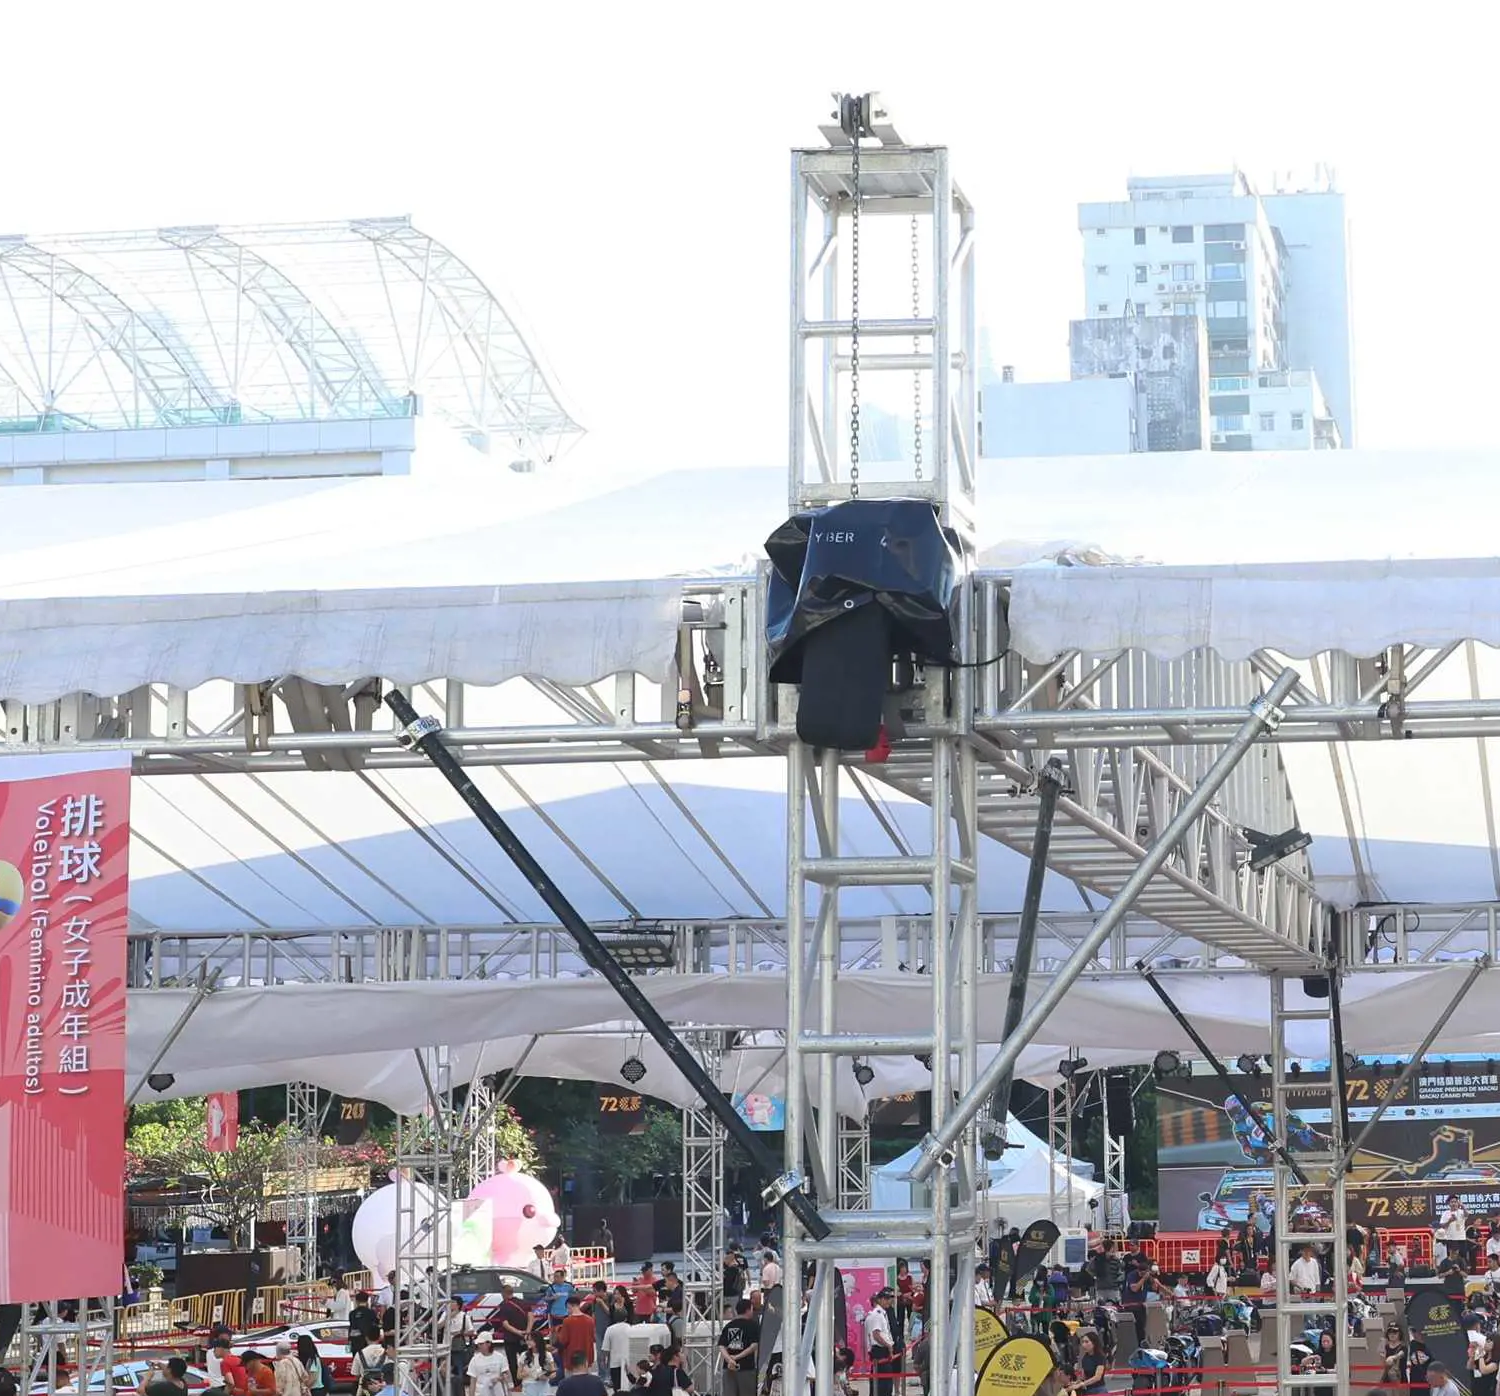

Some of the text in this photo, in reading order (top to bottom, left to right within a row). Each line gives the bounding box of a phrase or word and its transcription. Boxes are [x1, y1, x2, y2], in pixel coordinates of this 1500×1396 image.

[815, 532, 855, 543] YBER
[24, 799, 57, 1095] Voleibol (Feminino adultos)
[1345, 1079, 1370, 1101] 72
[600, 1096, 618, 1111] 72
[1366, 1197, 1389, 1217] 72
